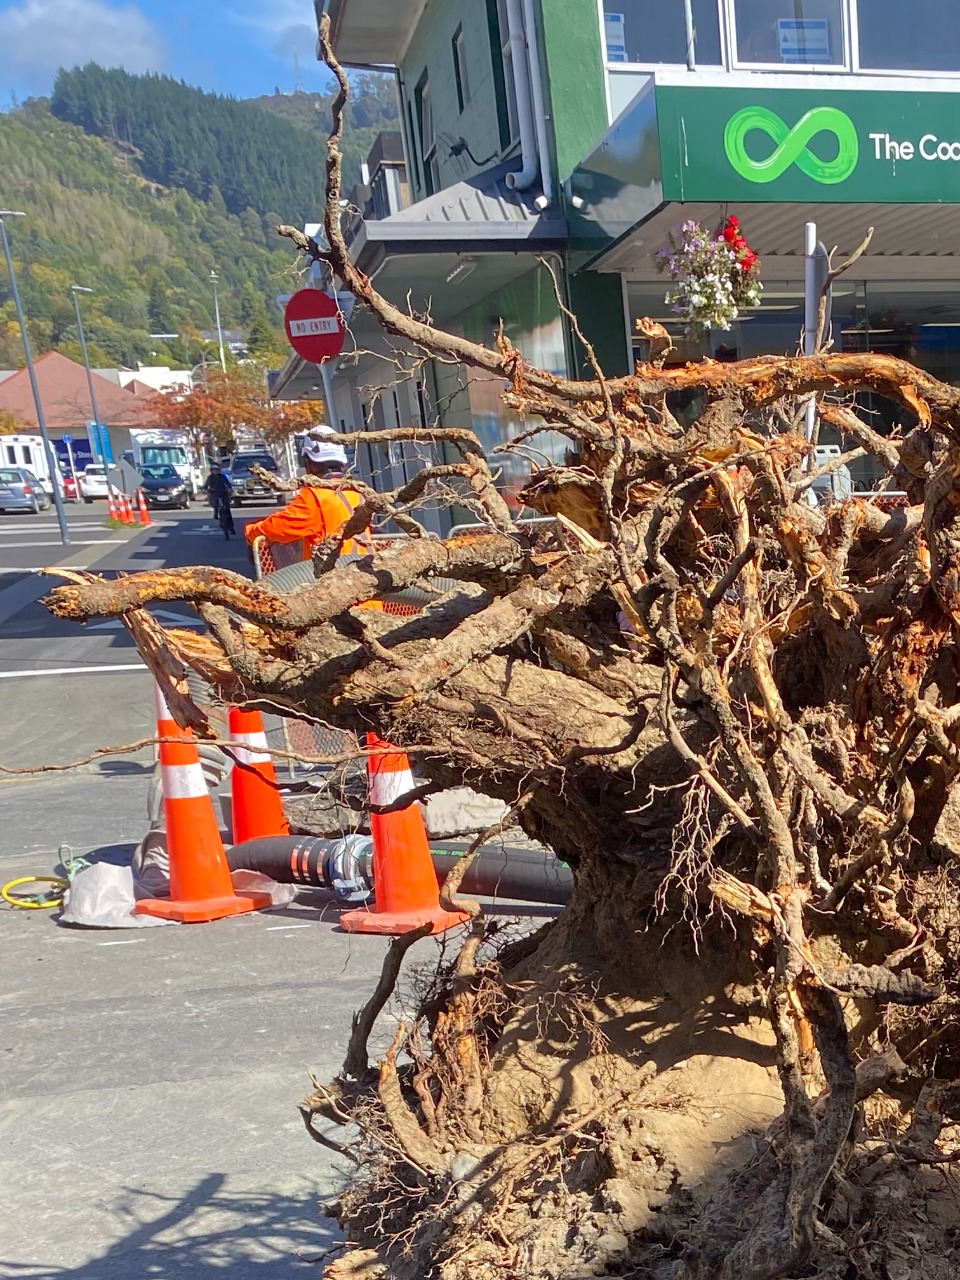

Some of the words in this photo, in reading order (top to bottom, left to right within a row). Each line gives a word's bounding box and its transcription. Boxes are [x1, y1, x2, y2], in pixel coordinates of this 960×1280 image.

[869, 133, 914, 160] The
[296, 322, 306, 333] NO
[310, 320, 331, 333] ENTRY
